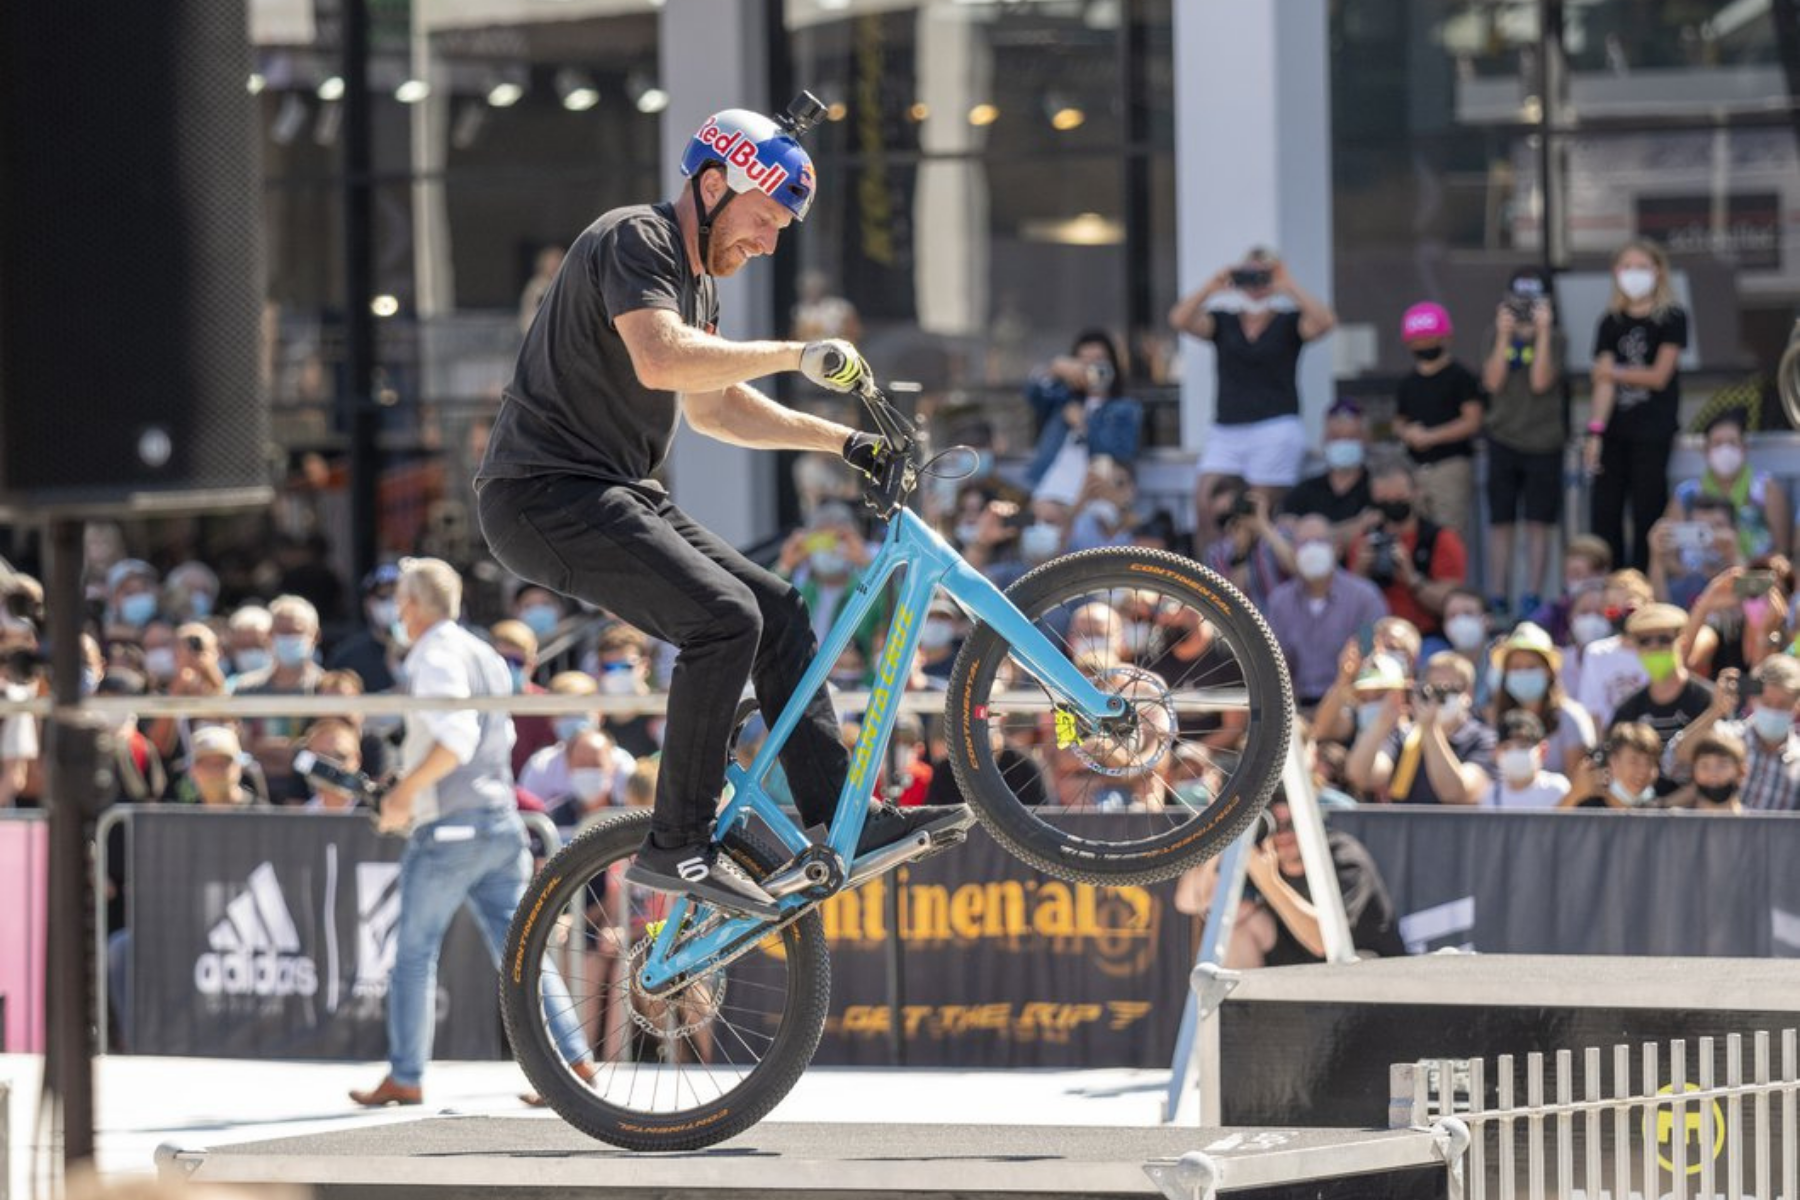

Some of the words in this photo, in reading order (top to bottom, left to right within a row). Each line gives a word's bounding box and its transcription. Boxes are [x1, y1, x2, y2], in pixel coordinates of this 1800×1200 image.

[728, 140, 787, 196] Bull
[1129, 562, 1232, 616] CONTINENTAL
[850, 687, 889, 792] SANTA
[880, 603, 915, 686] CRUZ
[963, 659, 980, 771] CONTINENTAL
[512, 876, 562, 983] CONTINENTAL
[617, 1108, 729, 1134] CONTINENTAL
